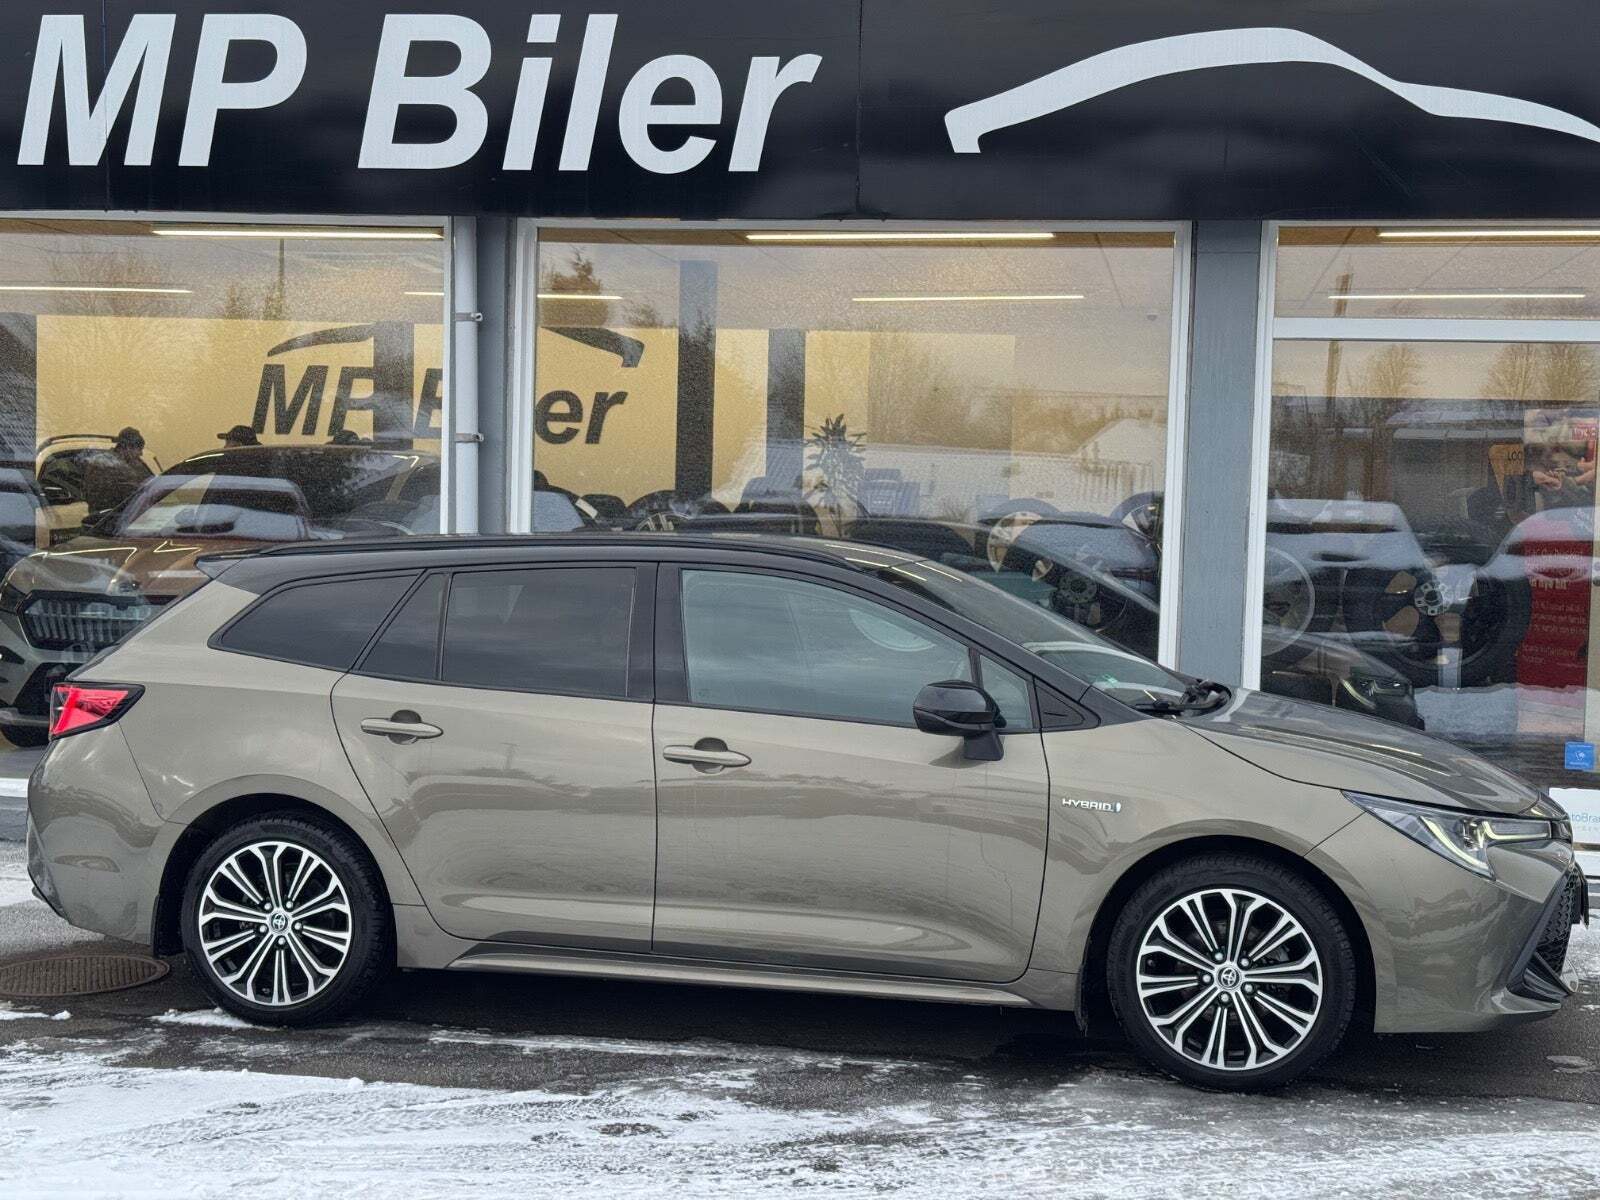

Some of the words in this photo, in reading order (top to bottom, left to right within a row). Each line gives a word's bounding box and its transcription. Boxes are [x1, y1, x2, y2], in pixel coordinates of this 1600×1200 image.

[17, 13, 308, 168] MP
[358, 13, 823, 175] Biler
[251, 363, 389, 437] MP
[1061, 798, 1114, 812] HYBRID
